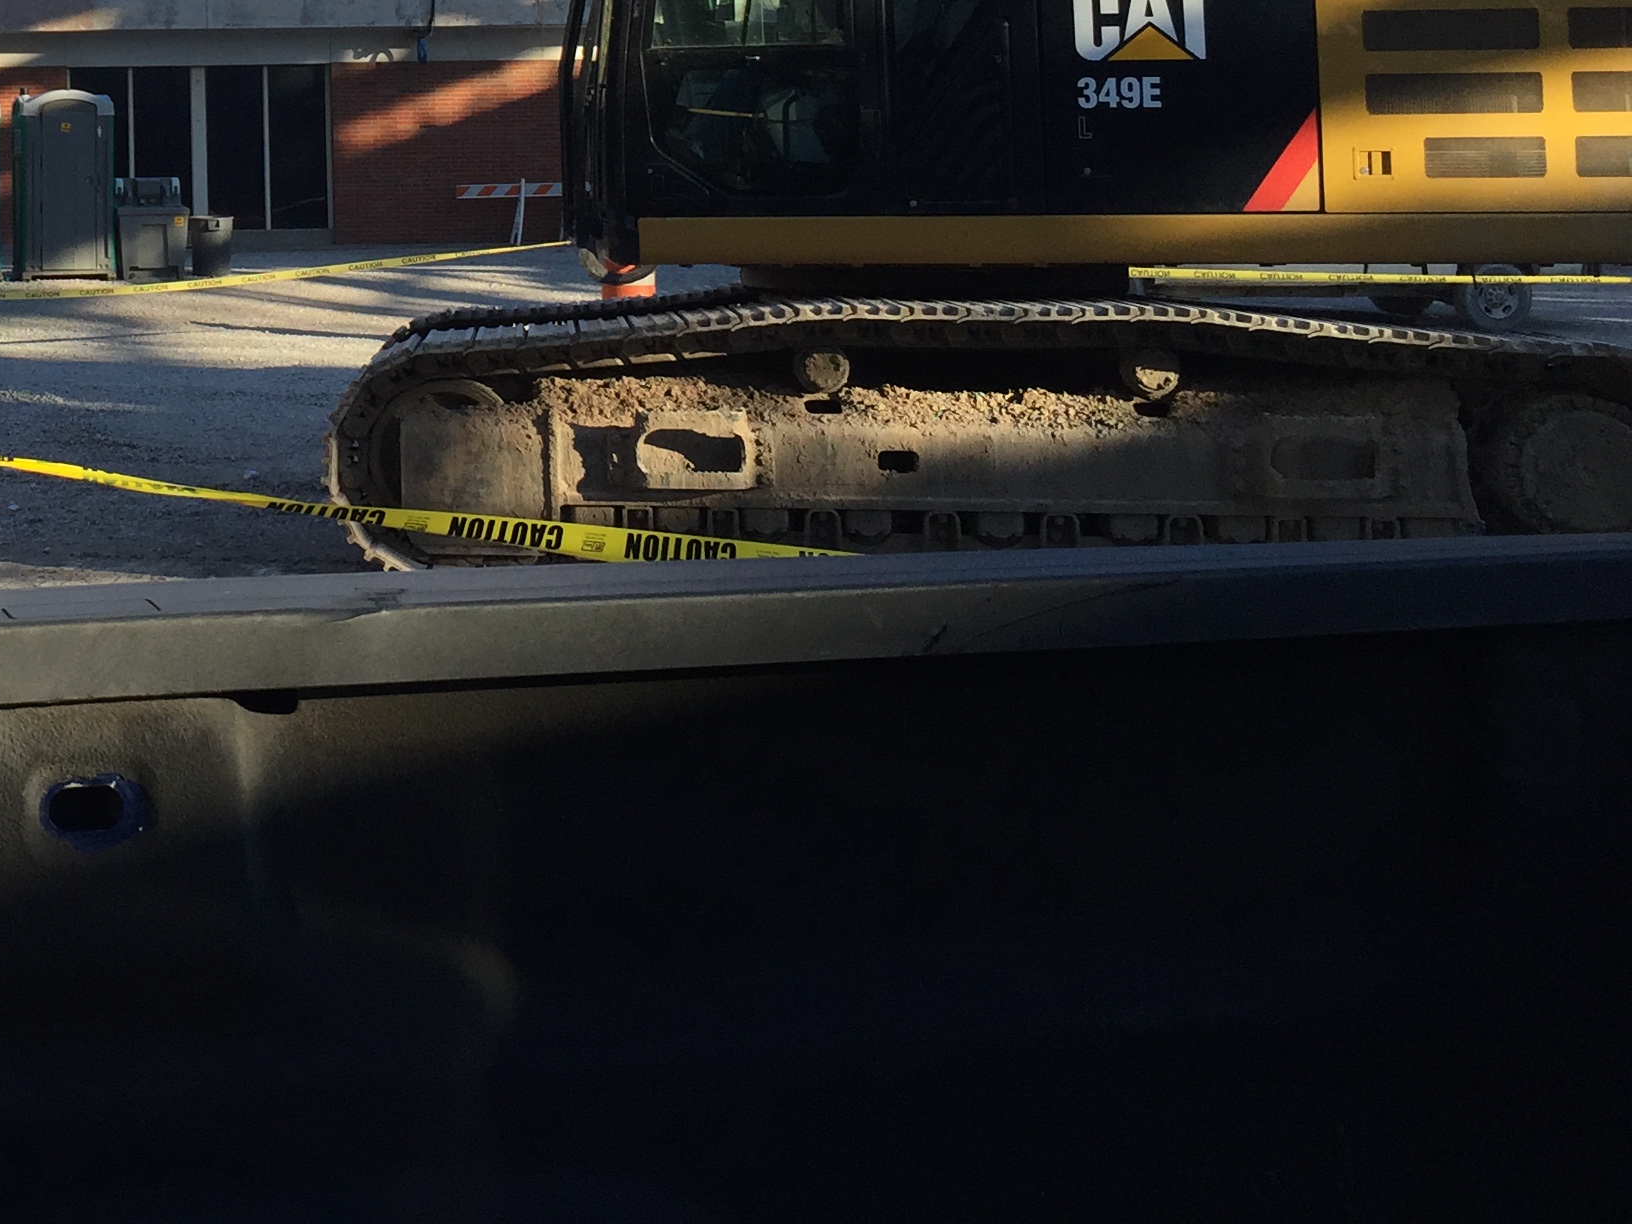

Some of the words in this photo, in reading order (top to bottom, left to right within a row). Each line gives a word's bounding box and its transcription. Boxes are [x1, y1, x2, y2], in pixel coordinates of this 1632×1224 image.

[1076, 76, 1163, 109] 349E
[1078, 115, 1093, 139] L
[79, 288, 114, 296] CAUTION
[348, 261, 383, 271] CAUTION
[448, 516, 564, 550] CAUTION
[624, 532, 737, 561] CAUTION
